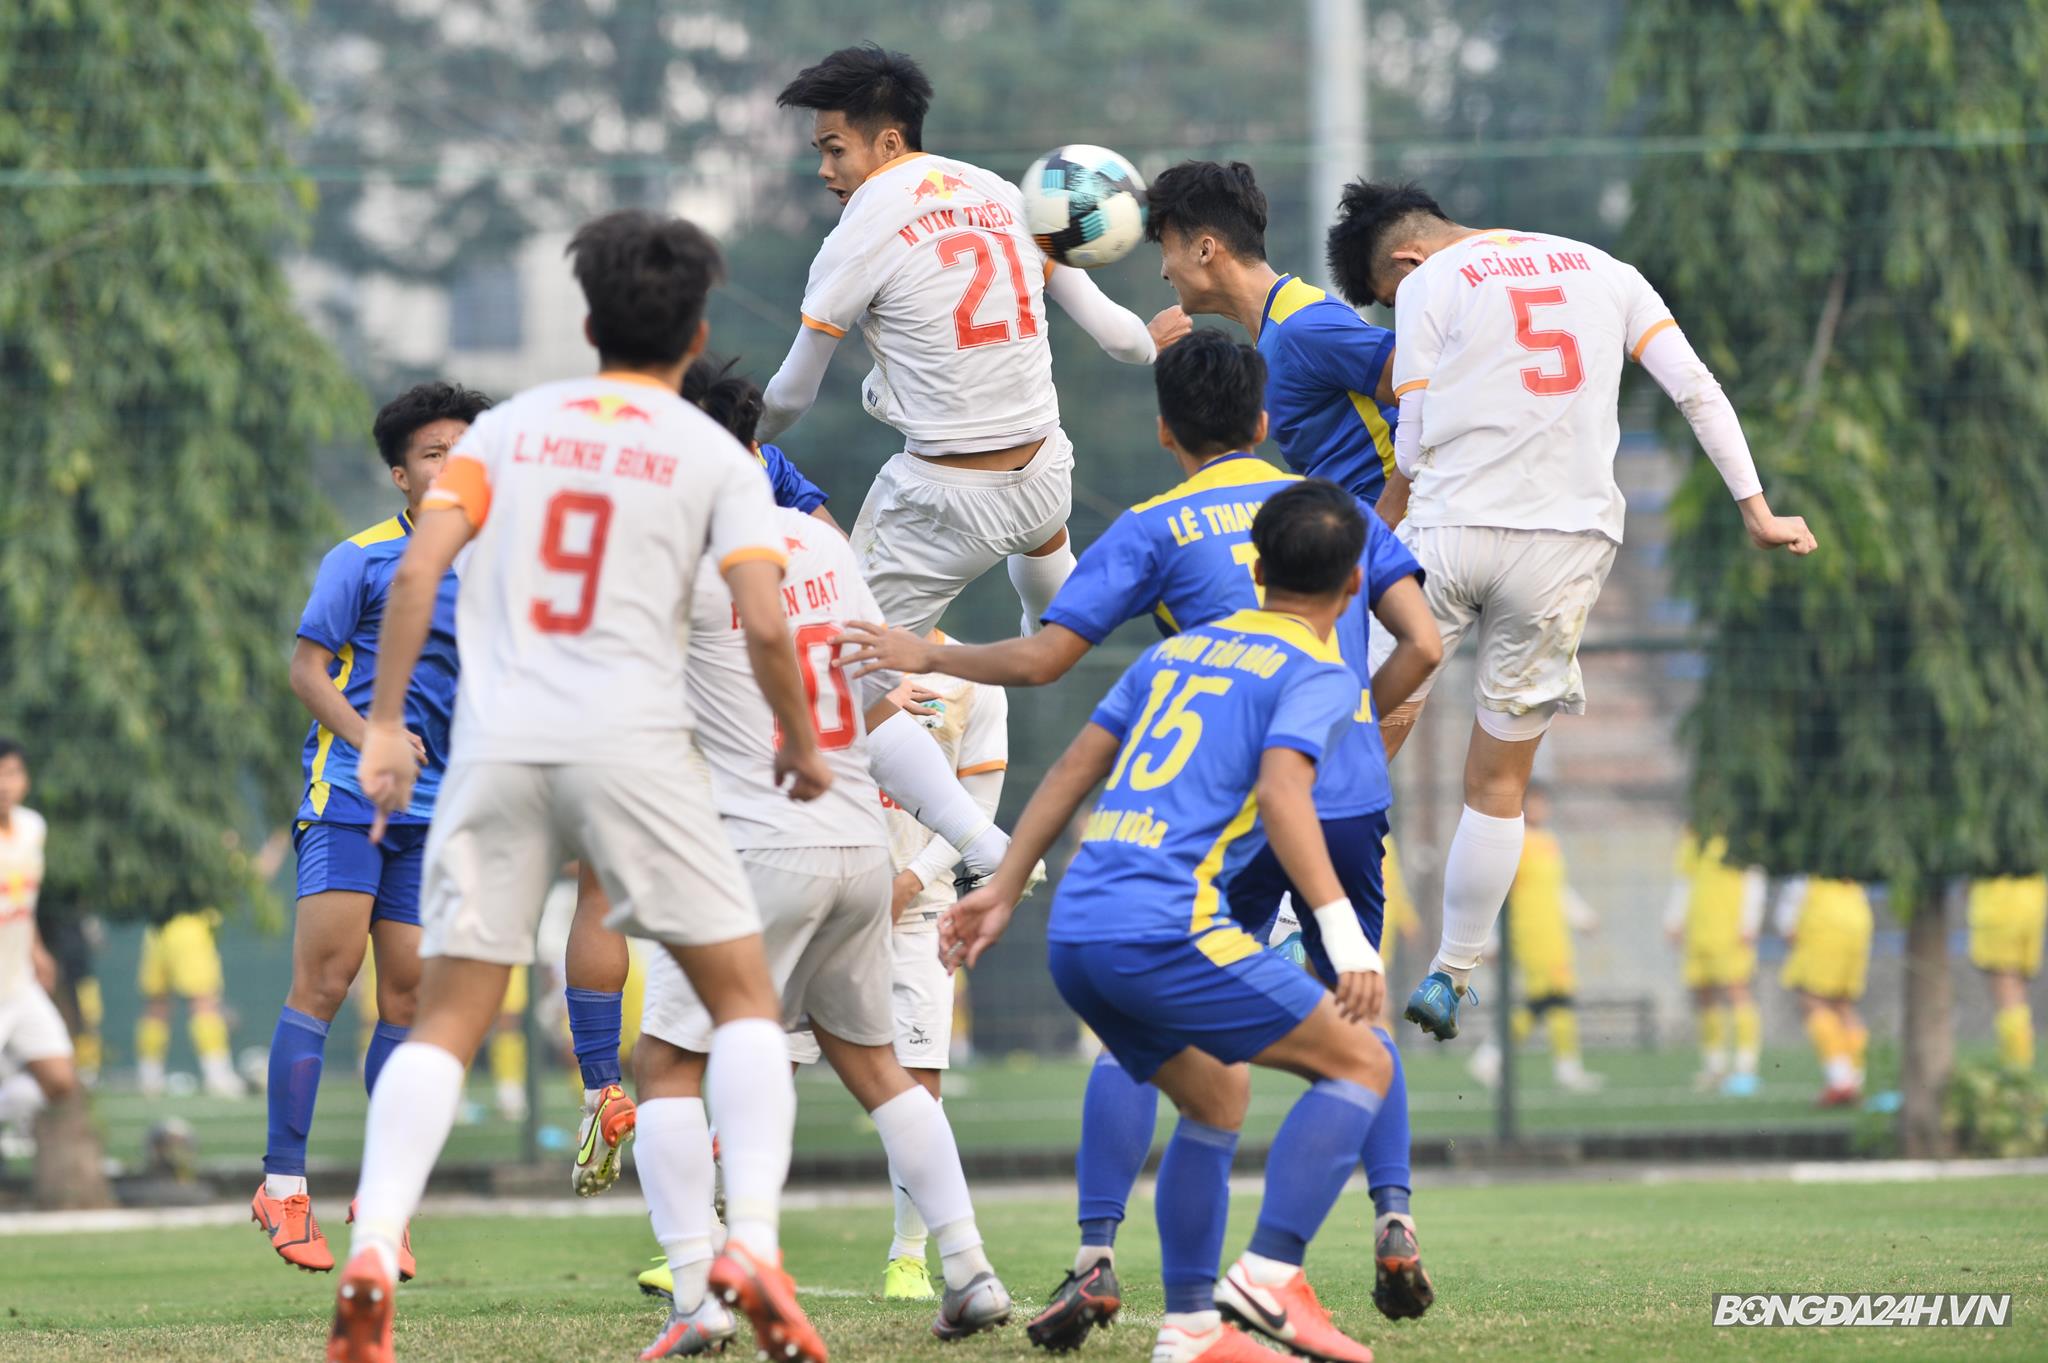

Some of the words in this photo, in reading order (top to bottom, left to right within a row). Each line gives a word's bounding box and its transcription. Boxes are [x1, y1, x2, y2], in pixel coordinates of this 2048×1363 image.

[898, 225, 920, 247] N
[936, 231, 1037, 350] 21
[1546, 252, 1591, 273] ANH
[1506, 286, 1586, 396] 5
[529, 489, 614, 636] 9
[1167, 506, 1204, 547] LÊ
[1105, 669, 1233, 791] 15
